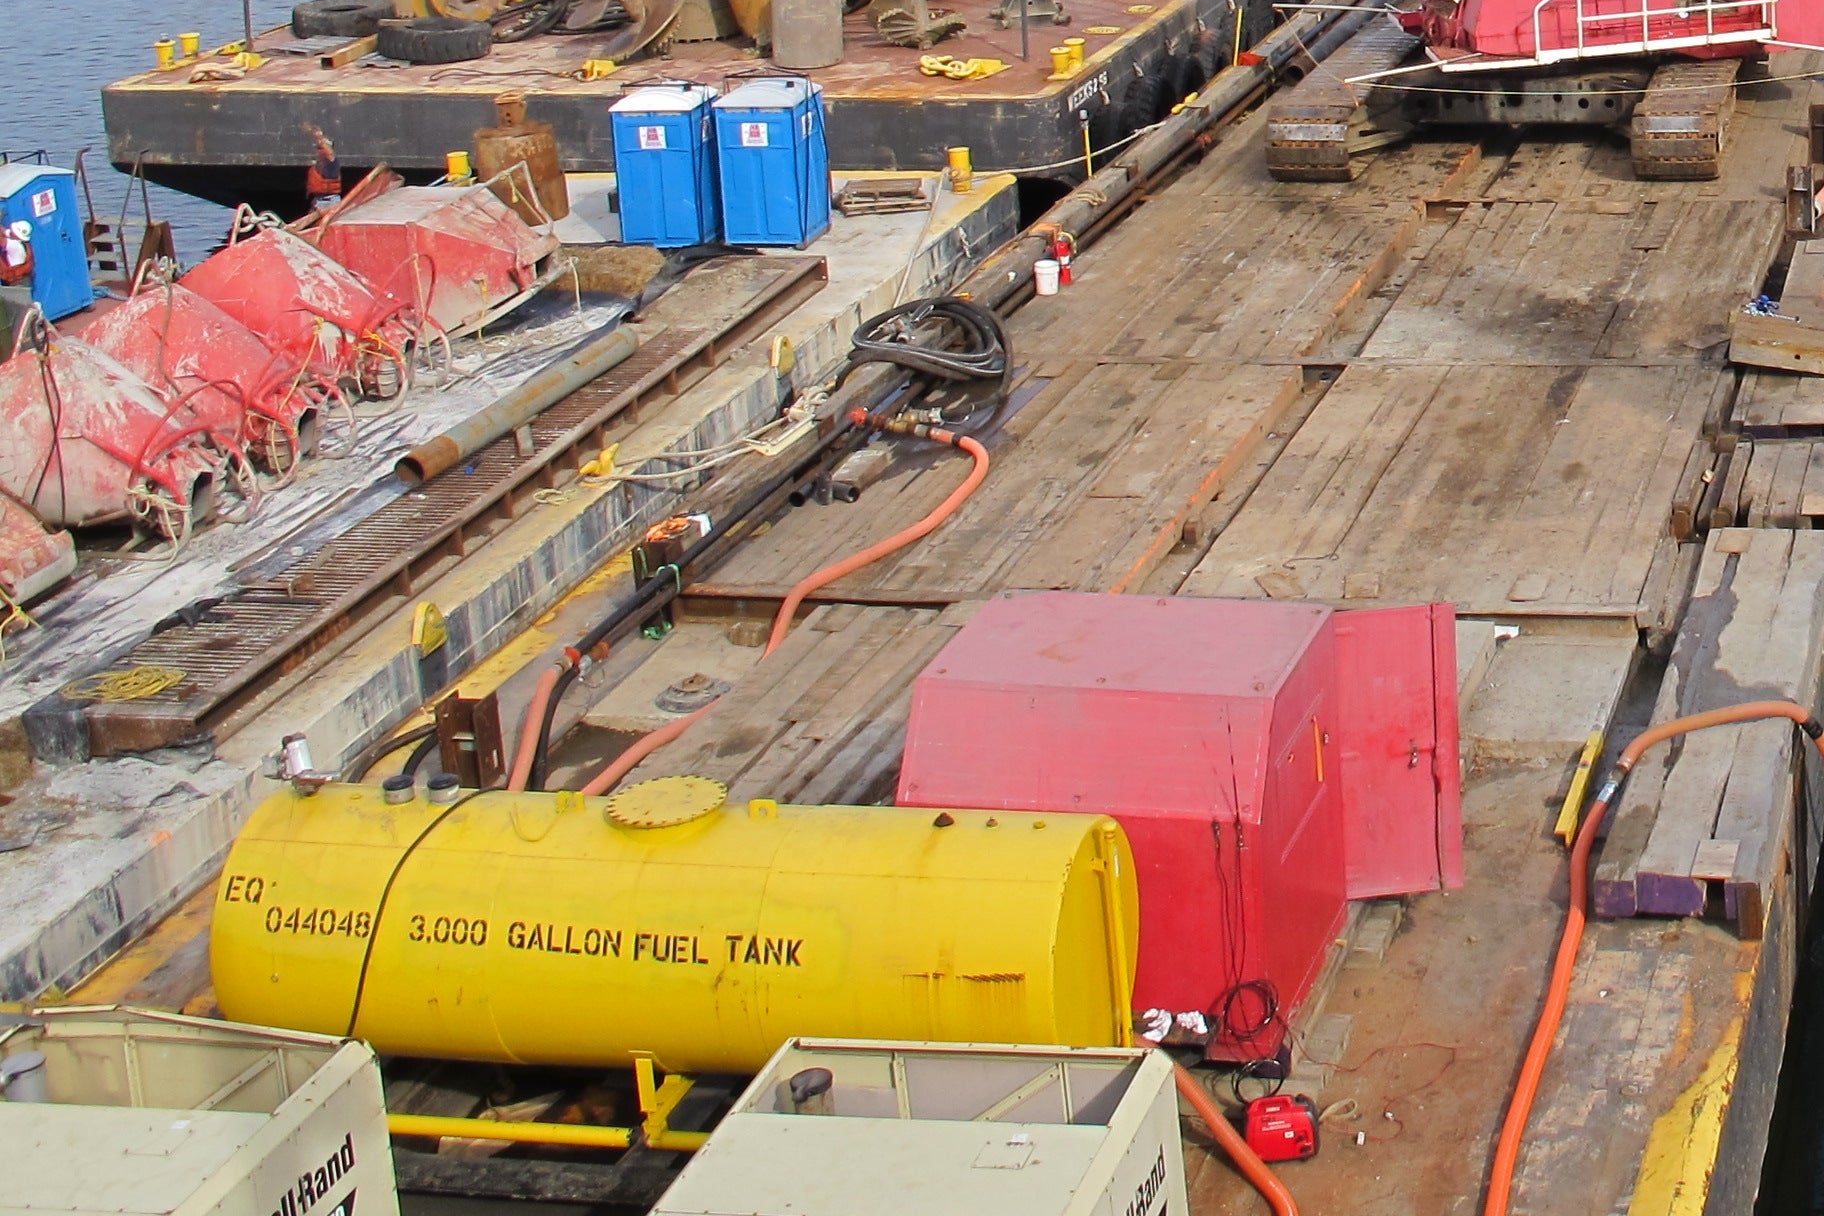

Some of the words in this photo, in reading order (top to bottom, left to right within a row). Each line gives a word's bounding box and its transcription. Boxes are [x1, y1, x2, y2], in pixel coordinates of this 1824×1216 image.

[225, 875, 264, 903] EQ
[266, 906, 372, 939] 044048
[507, 921, 623, 958] GALLON
[633, 931, 709, 964] FUEL
[726, 934, 805, 967] TANK
